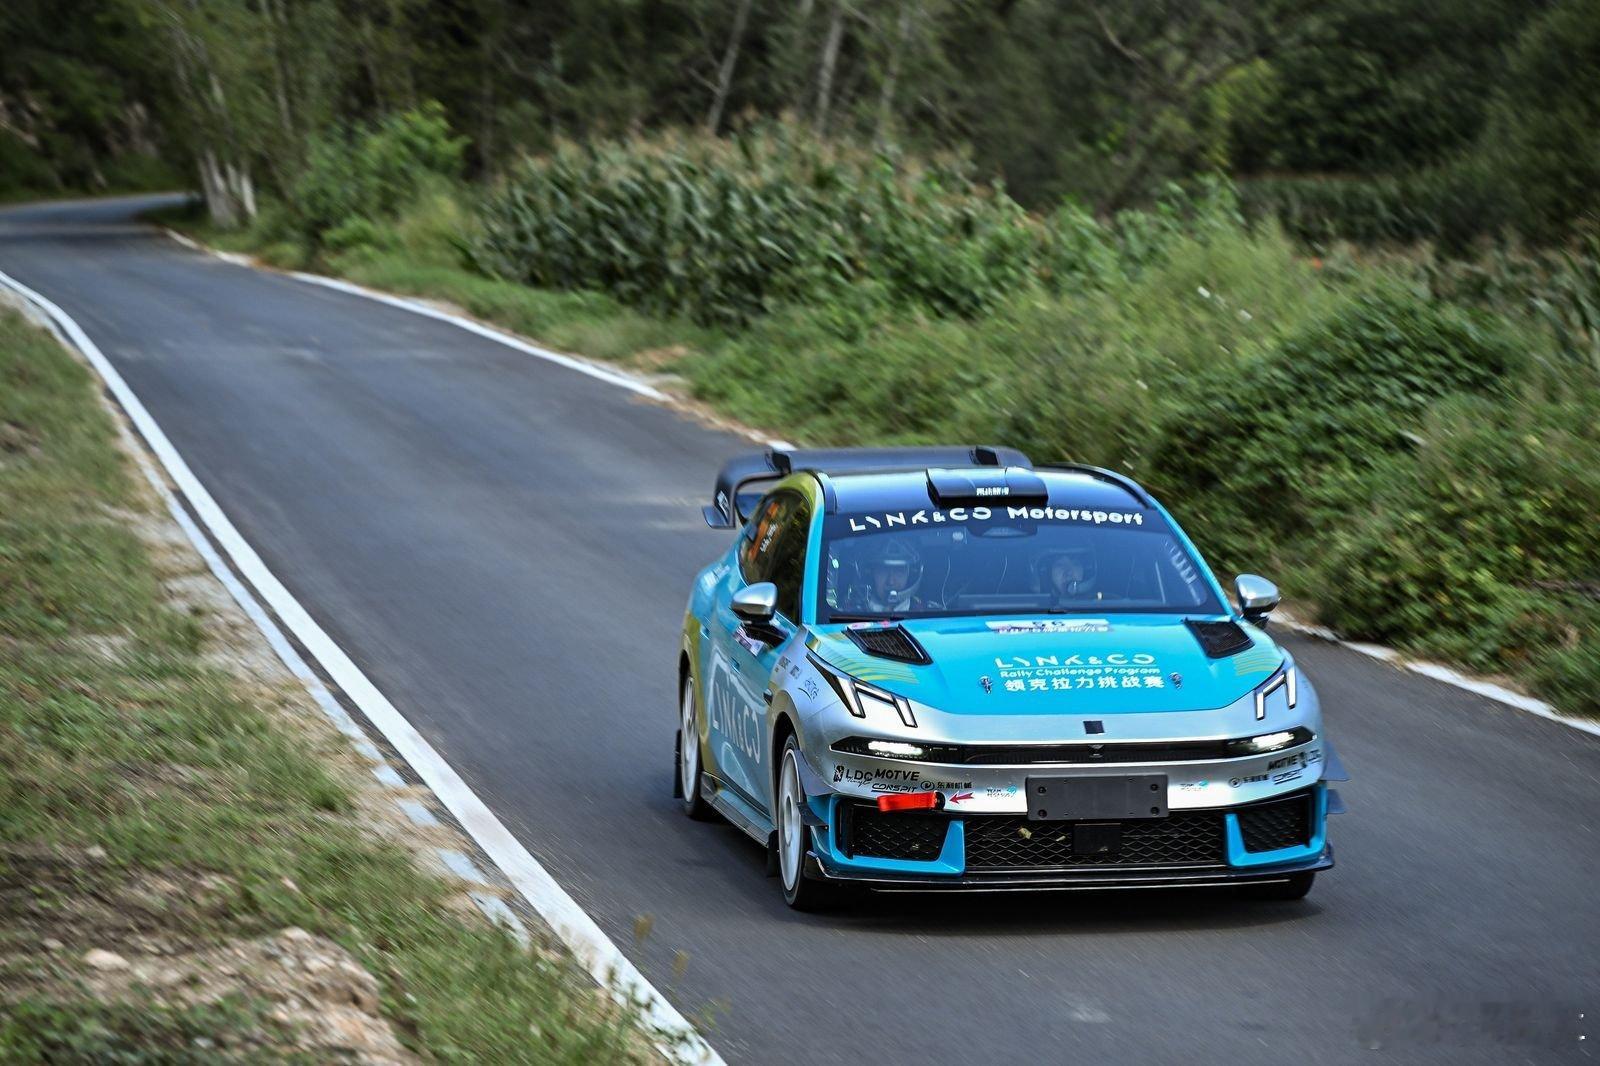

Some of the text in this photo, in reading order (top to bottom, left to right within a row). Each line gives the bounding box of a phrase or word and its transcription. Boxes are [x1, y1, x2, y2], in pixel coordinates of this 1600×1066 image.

[1007, 505, 1143, 525] Motorsport
[1000, 667, 1161, 678] Rally Challenge Program
[845, 768, 873, 781] LDC
[874, 768, 920, 781] MOTVE
